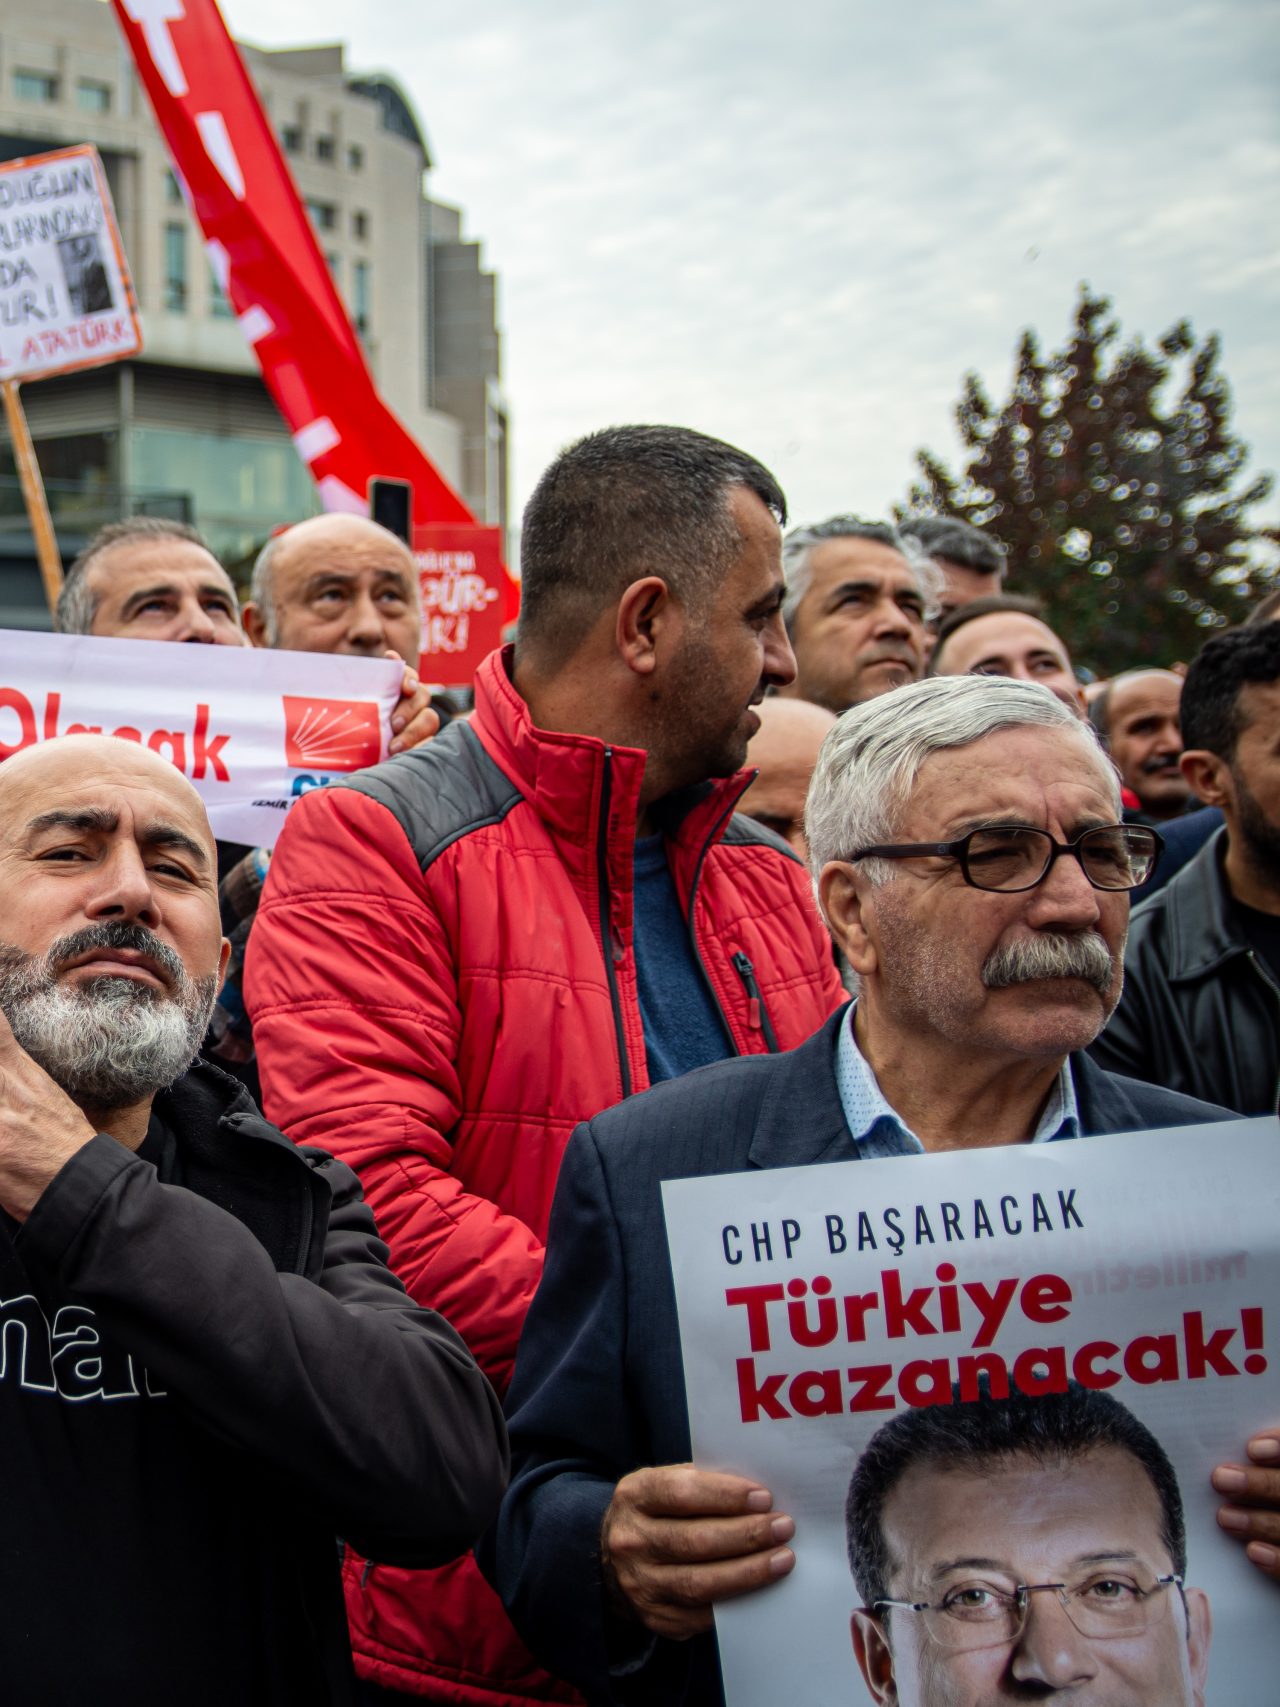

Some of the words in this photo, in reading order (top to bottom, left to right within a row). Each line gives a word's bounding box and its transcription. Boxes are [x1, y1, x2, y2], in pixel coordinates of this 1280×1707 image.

[722, 1219, 802, 1265] CHP
[826, 1190, 1083, 1257] BAŞARACAK
[726, 1264, 1072, 1348] Türkiye
[735, 1307, 1268, 1423] kazanacak!
